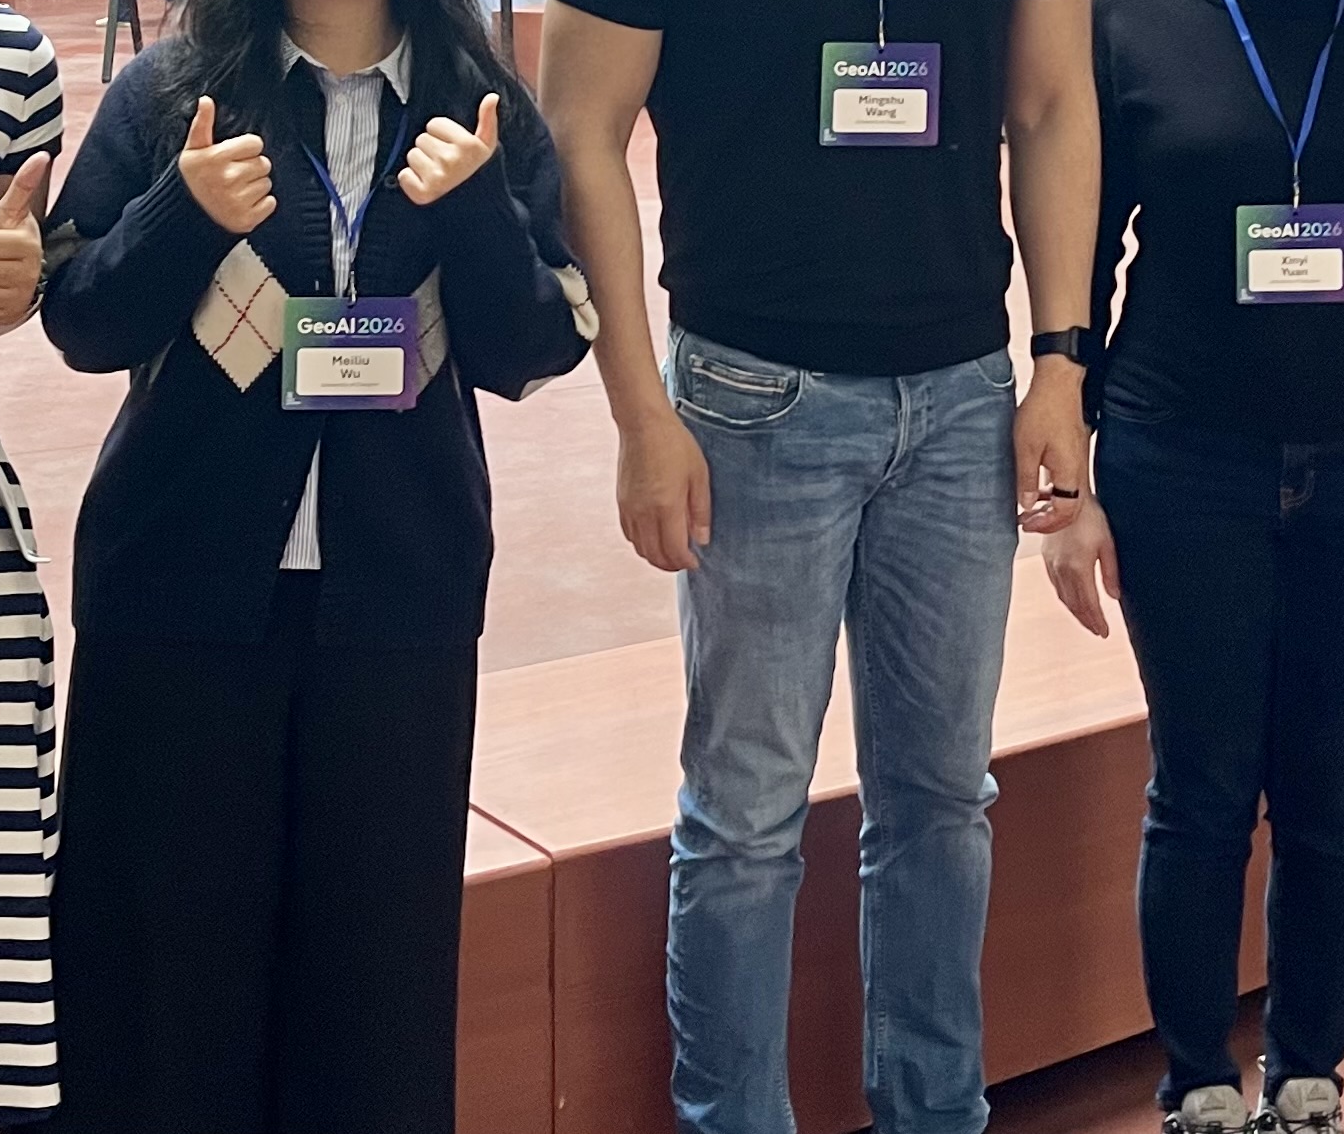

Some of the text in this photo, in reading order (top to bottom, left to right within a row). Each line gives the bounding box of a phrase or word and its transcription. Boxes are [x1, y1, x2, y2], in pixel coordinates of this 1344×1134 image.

[833, 61, 928, 77] GeoAI 2026
[858, 95, 904, 106] Mingshu
[865, 107, 896, 118] Wang
[1247, 221, 1342, 238] GeoAI 2026
[297, 317, 405, 334] GeoAI 2026
[340, 369, 360, 379] Wu
